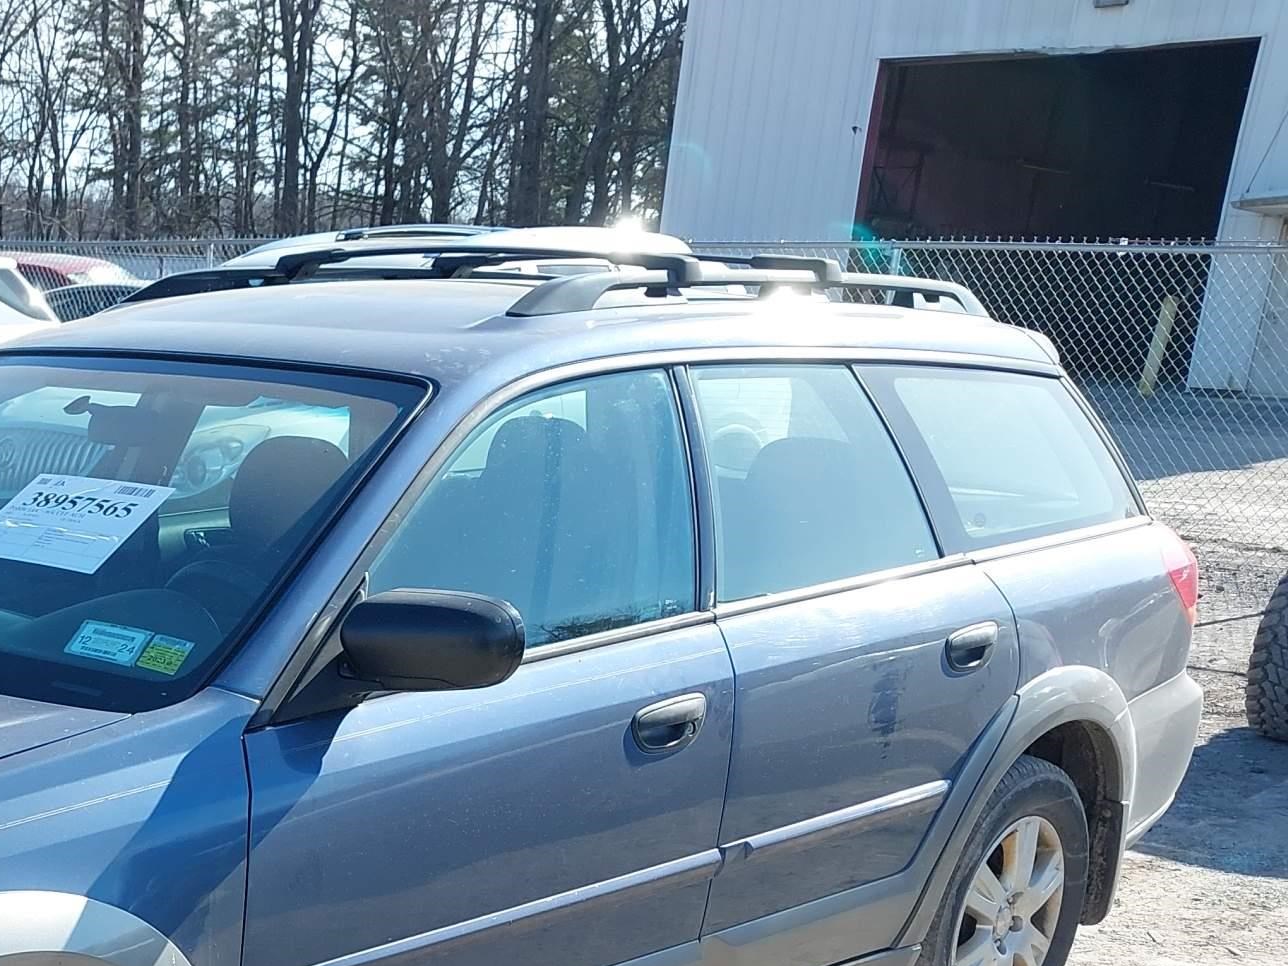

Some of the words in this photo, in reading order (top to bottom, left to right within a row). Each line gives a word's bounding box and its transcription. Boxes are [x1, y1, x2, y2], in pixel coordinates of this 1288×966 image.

[23, 491, 139, 518] 38957565
[78, 634, 92, 646] 12
[118, 643, 135, 655] 24
